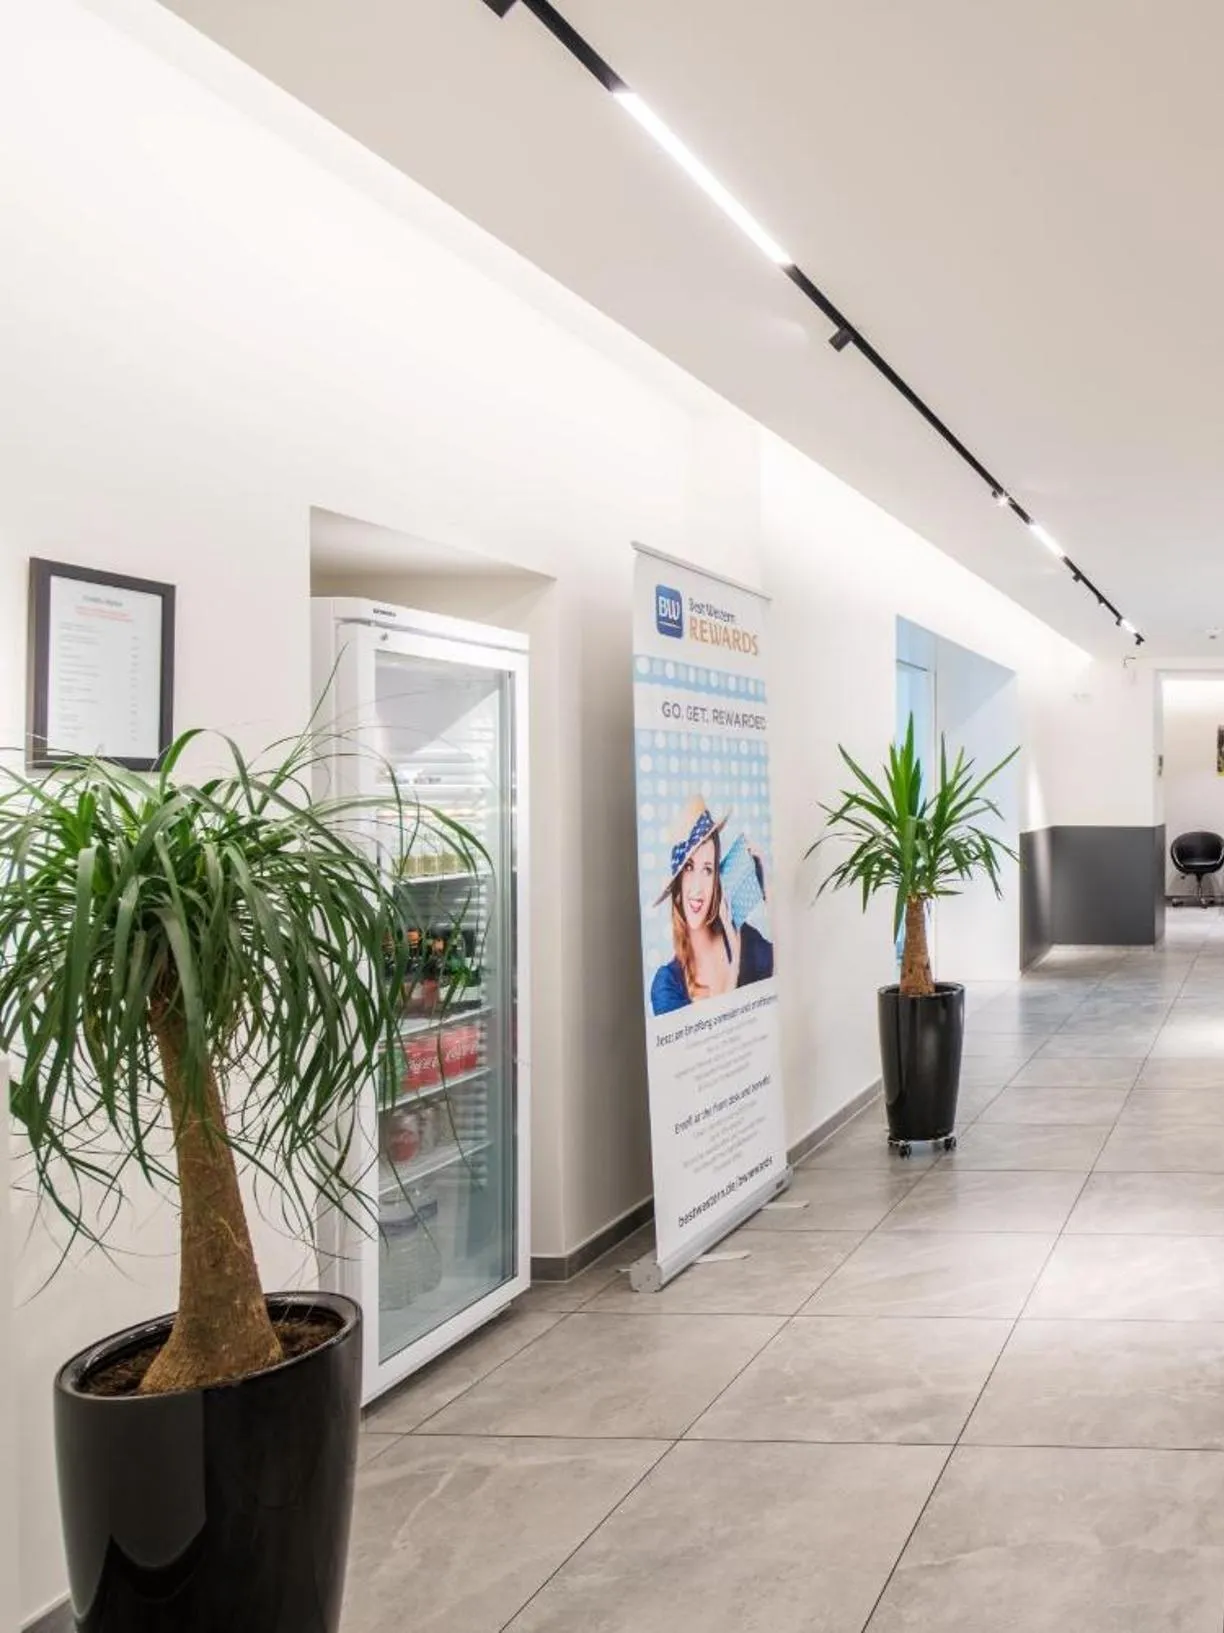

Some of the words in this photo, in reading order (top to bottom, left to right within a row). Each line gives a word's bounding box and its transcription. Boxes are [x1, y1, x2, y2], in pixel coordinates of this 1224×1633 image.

[658, 596, 681, 620] BW
[689, 616, 759, 656] REWARDS
[661, 701, 684, 720] GO.
